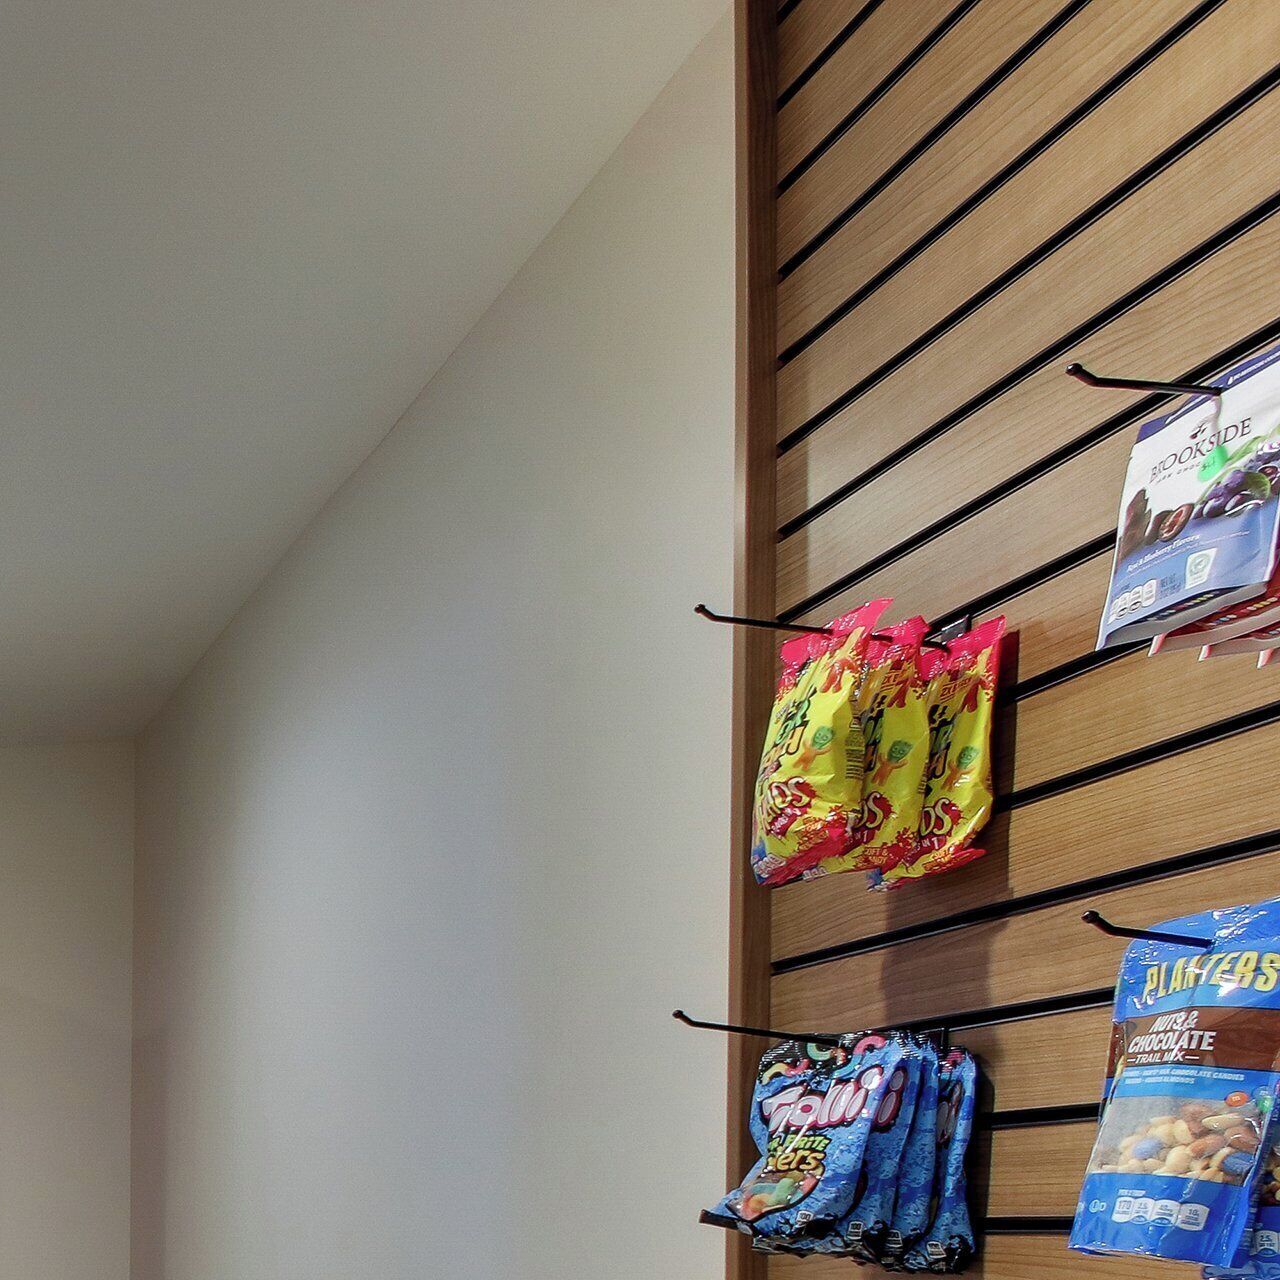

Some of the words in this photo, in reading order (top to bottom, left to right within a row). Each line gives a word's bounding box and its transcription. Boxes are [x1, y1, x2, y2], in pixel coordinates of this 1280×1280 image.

[1149, 416, 1253, 483] BROOKSIDE
[1142, 949, 1280, 1004] PLANTERS
[1127, 1031, 1217, 1054] CHOCOLATE
[1135, 1053, 1163, 1065] TRAIL
